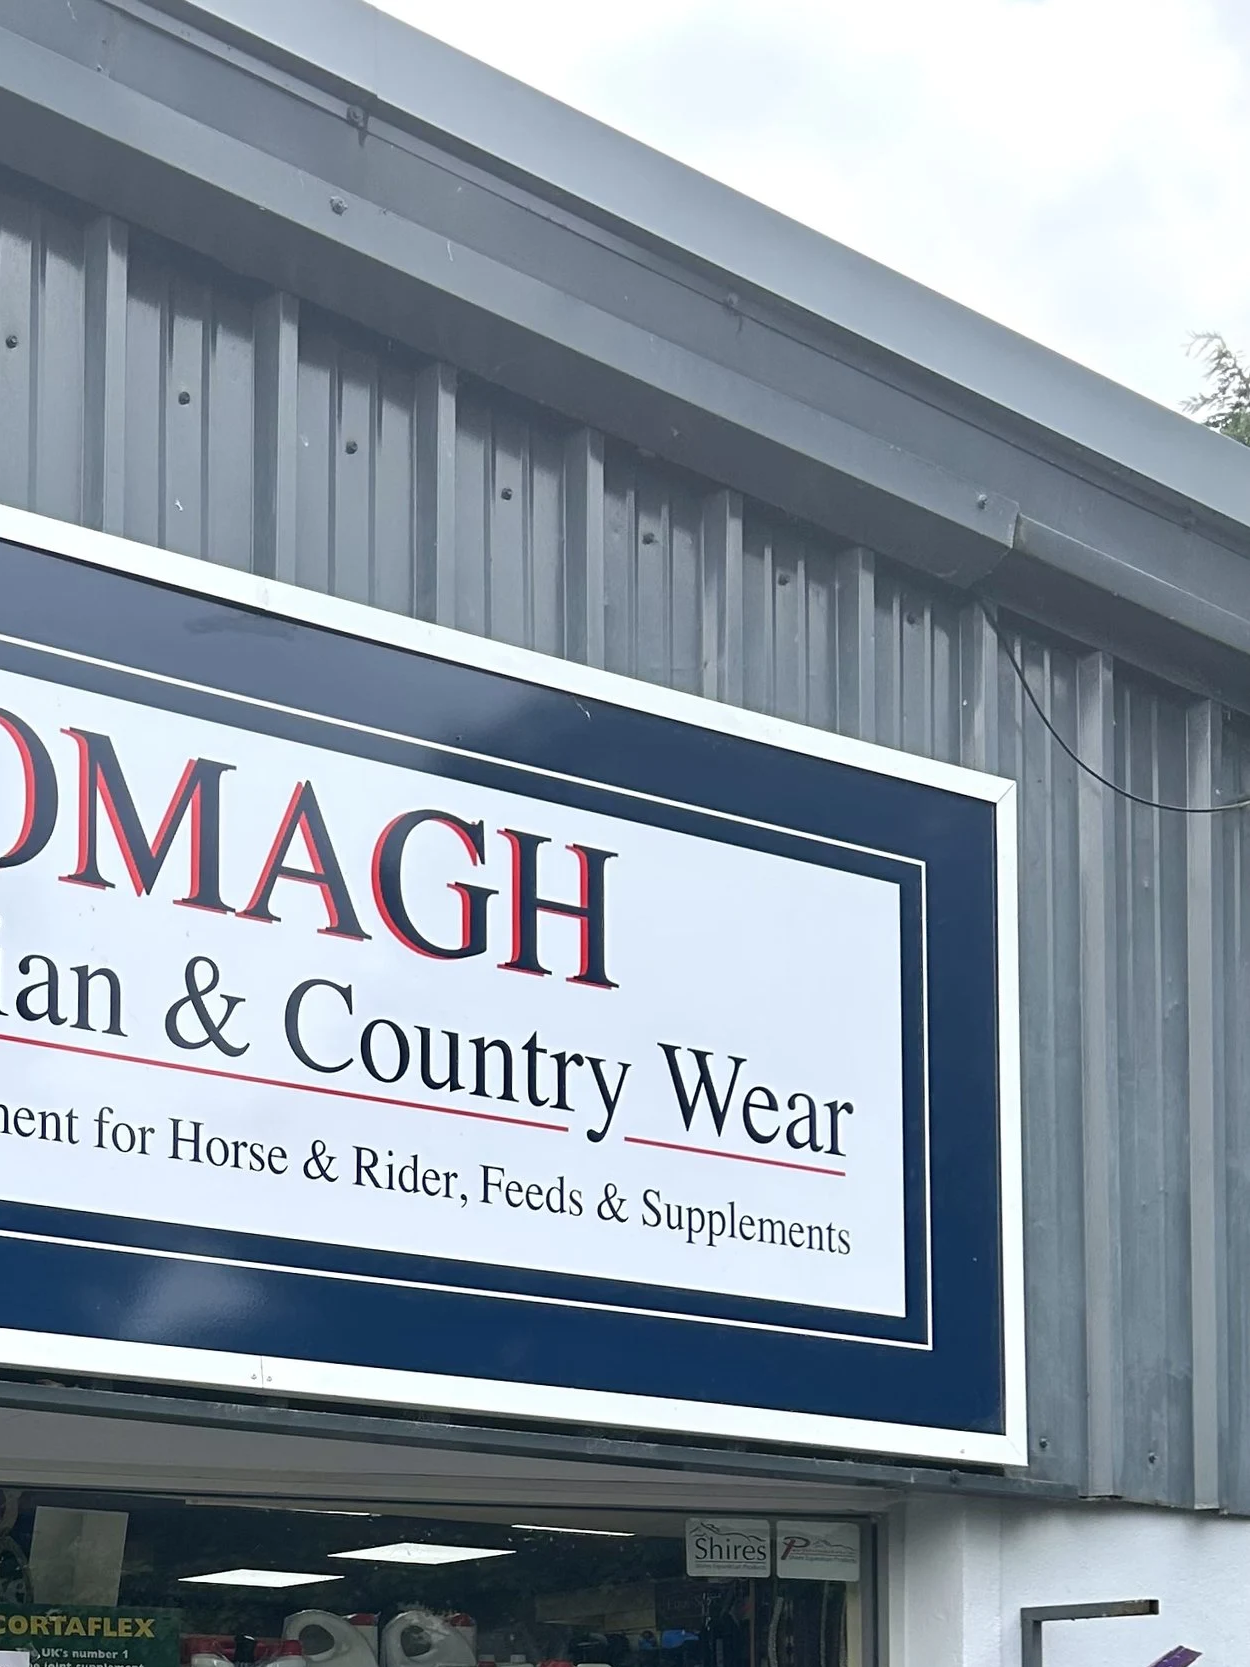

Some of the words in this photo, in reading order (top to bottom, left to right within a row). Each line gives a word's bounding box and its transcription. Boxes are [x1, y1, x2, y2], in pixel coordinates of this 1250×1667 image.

[164, 955, 250, 1058] &
[284, 979, 632, 1142] Country
[657, 1041, 854, 1157] Wear
[94, 1107, 155, 1156] for
[169, 1119, 288, 1176] Horse
[303, 1139, 339, 1182] &
[352, 1146, 468, 1207] Rider,
[479, 1164, 583, 1217] Feeds
[597, 1182, 629, 1224] &
[642, 1189, 851, 1256] Supplements
[695, 1537, 767, 1561] Shires
[41, 1649, 68, 1658] UK's
[72, 1650, 118, 1659] number
[122, 1650, 128, 1658] 1
